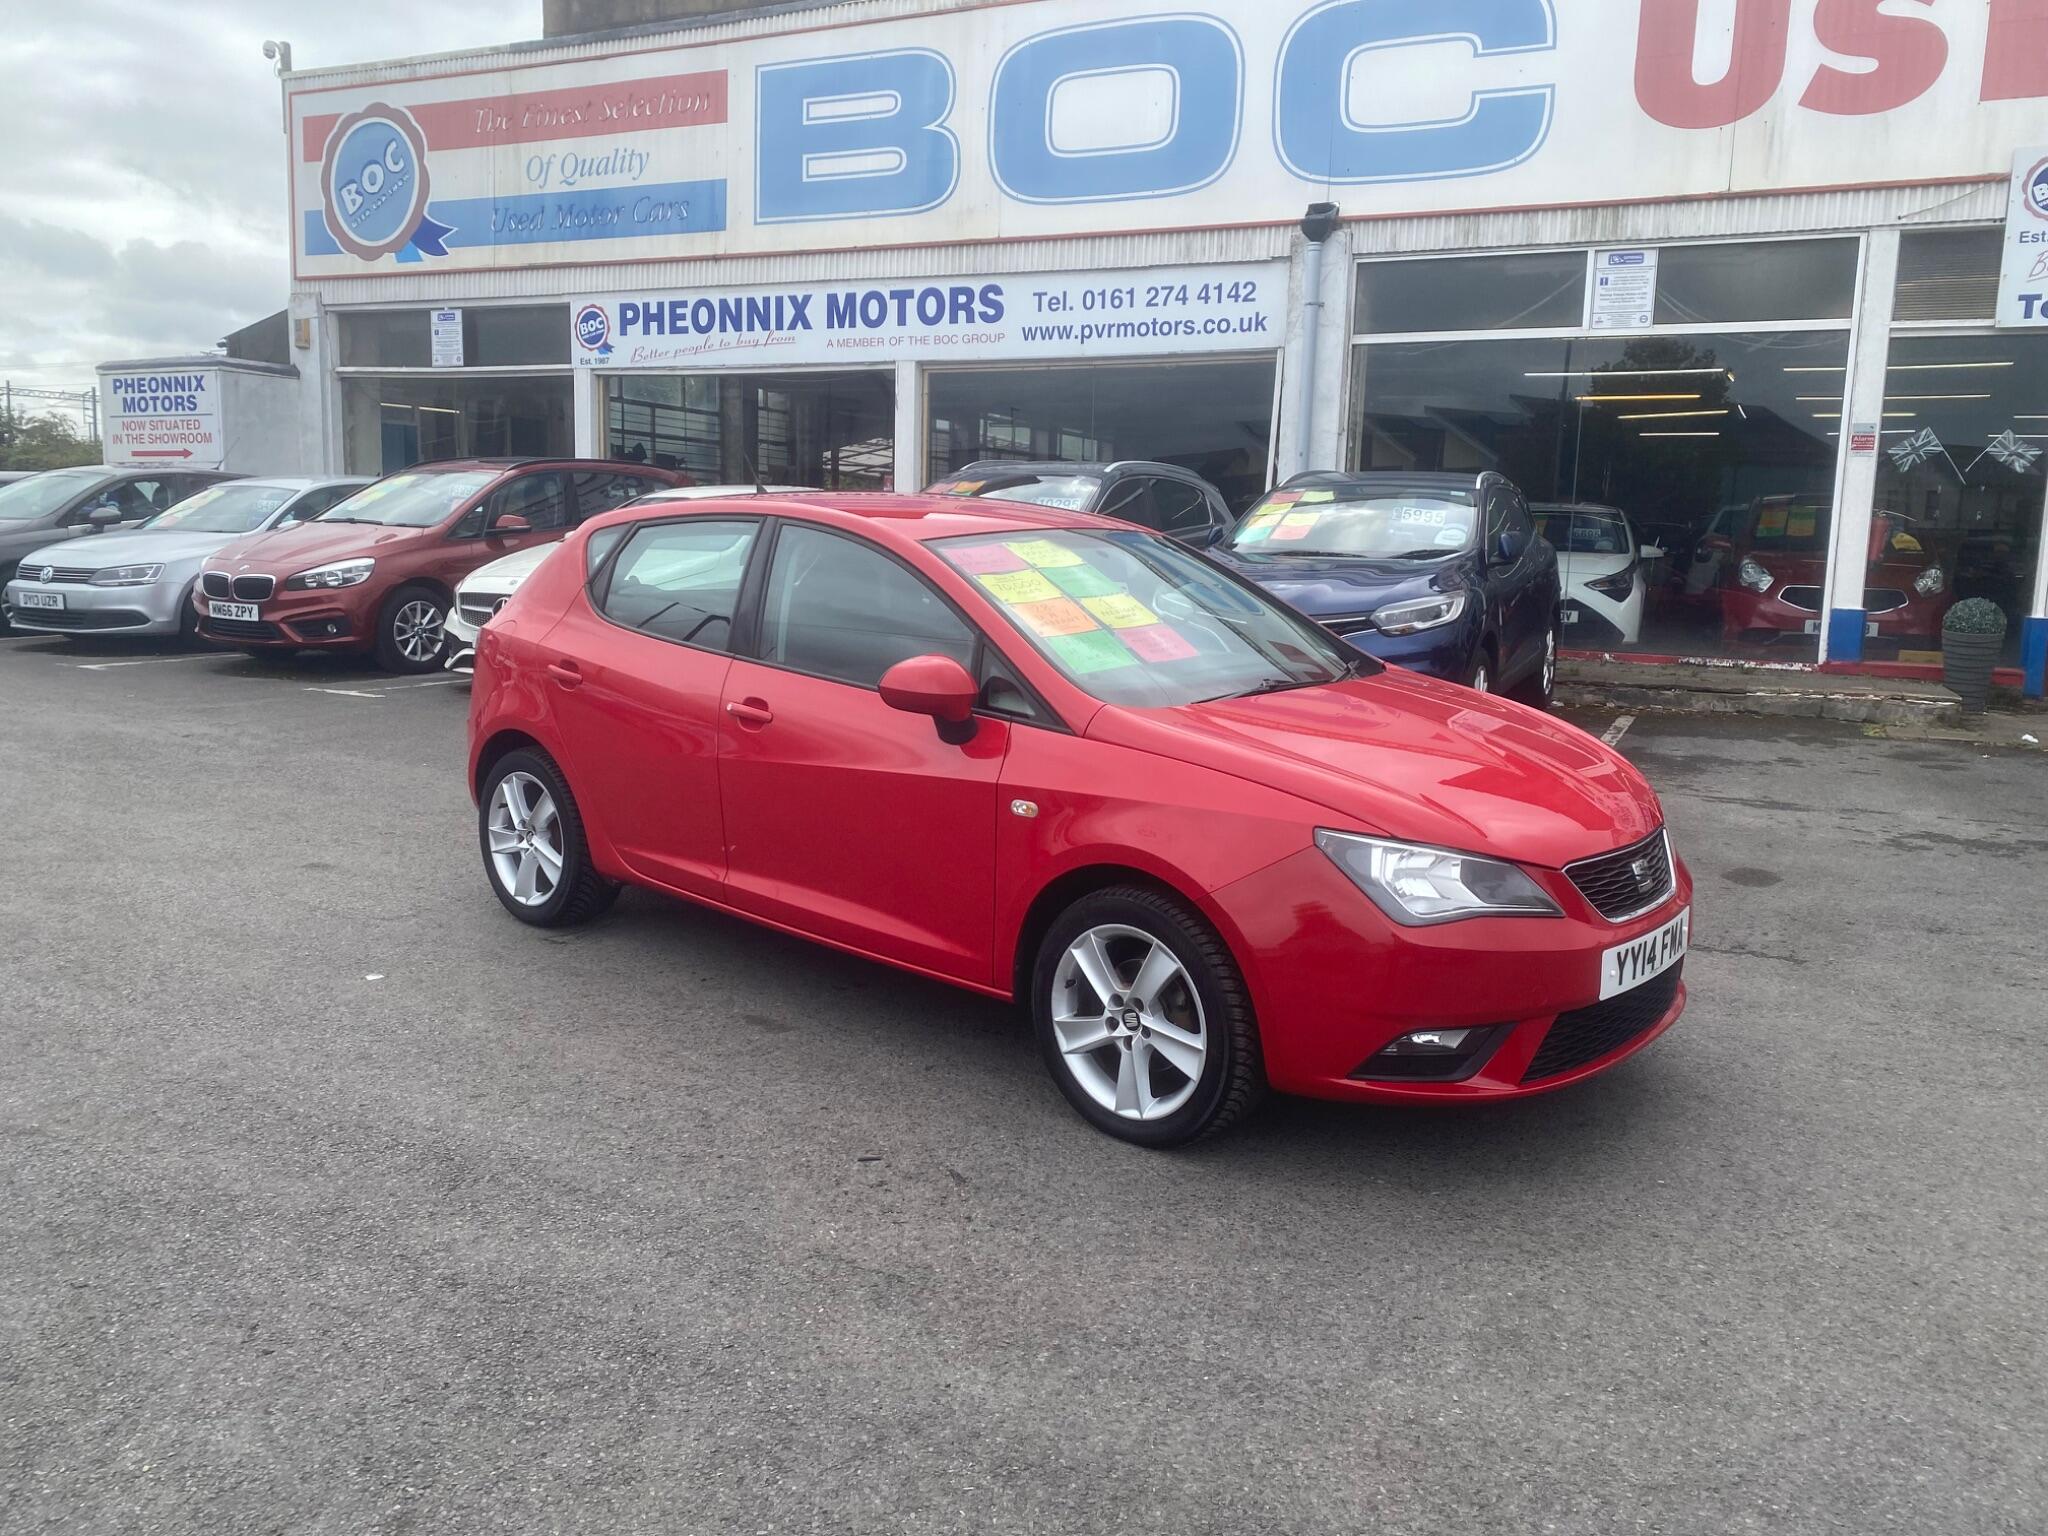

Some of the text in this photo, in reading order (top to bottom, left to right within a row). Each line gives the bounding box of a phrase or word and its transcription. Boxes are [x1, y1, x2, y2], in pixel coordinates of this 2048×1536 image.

[474, 88, 710, 134] The Finest Selection
[755, 0, 1556, 224] BOC
[340, 139, 405, 216] BOC
[526, 148, 650, 189] Of Quality
[490, 196, 689, 233] Used Motor Cars
[619, 284, 1005, 336] PHEONNIX MOTORS
[1032, 281, 1257, 313] Tel. 0161 274 4142
[580, 317, 604, 335] BOC
[826, 332, 1006, 348] A MEMBER OF THE BOC GROUP
[1021, 311, 1268, 344] www.pvrmotors.co.uk
[580, 358, 592, 366] Est.
[630, 328, 796, 364] Better people to buy from
[112, 374, 206, 395] PHEONNIX
[122, 394, 198, 413] MOTORS
[112, 432, 213, 445] IN THE SHOWROOM
[121, 418, 201, 432] NOW SITUATED
[41, 595, 58, 607] UZR
[234, 605, 254, 619] ZPY
[1616, 918, 1683, 986] YY14 FMA
